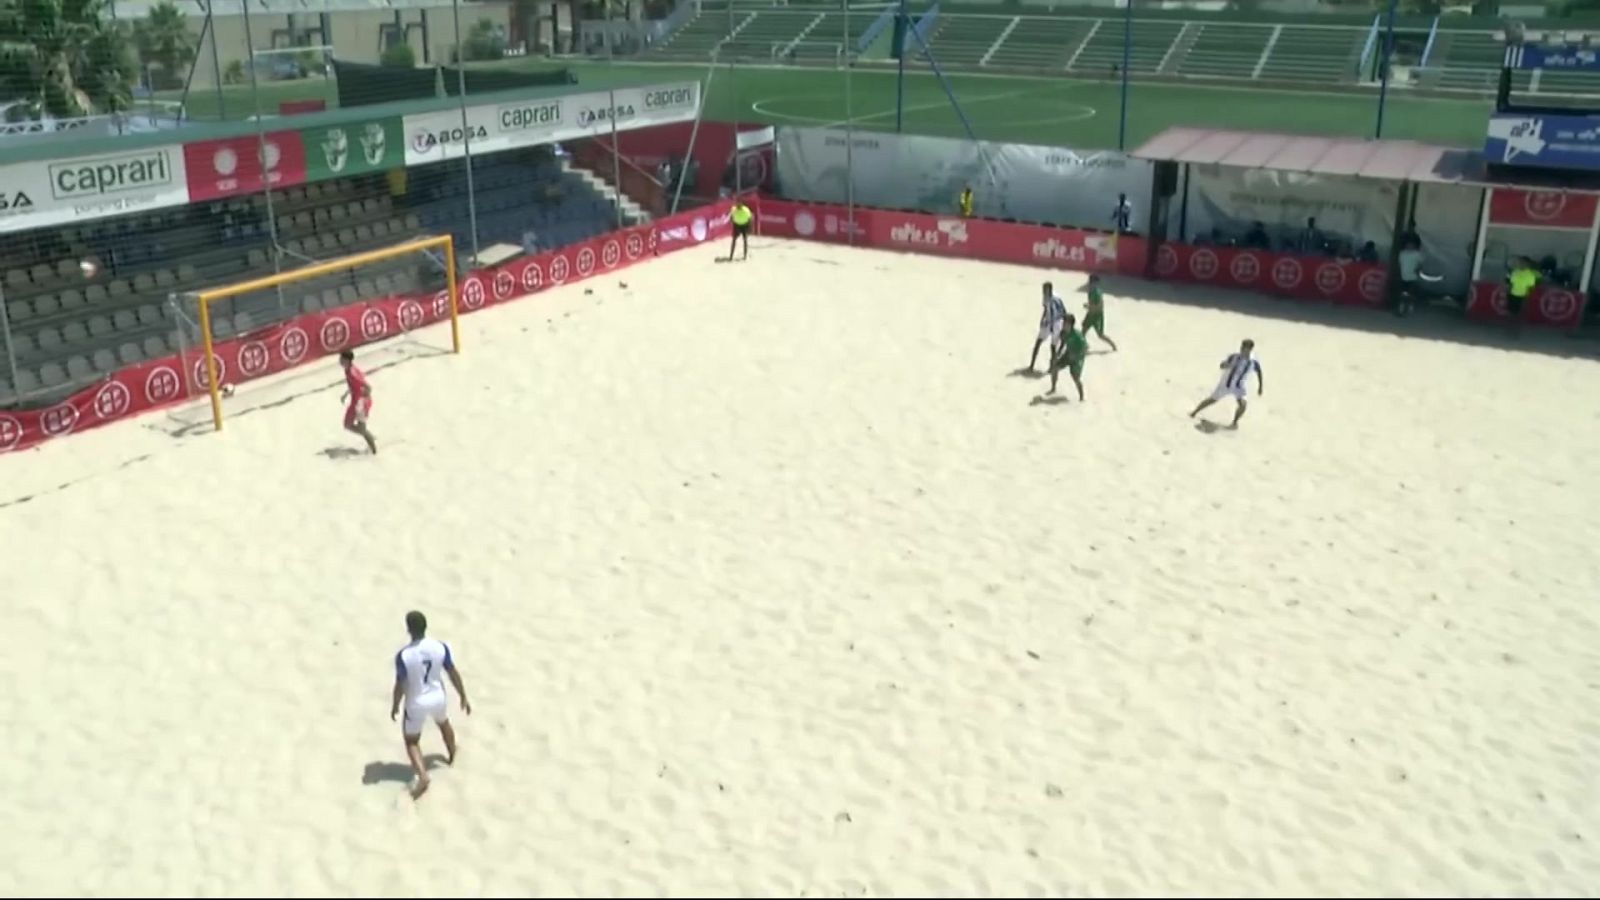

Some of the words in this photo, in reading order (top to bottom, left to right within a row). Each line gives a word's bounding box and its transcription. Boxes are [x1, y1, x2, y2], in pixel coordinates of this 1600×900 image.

[645, 86, 691, 107] caprari
[502, 102, 560, 129] caprari
[57, 151, 165, 194] caprari
[422, 659, 432, 684] 7
